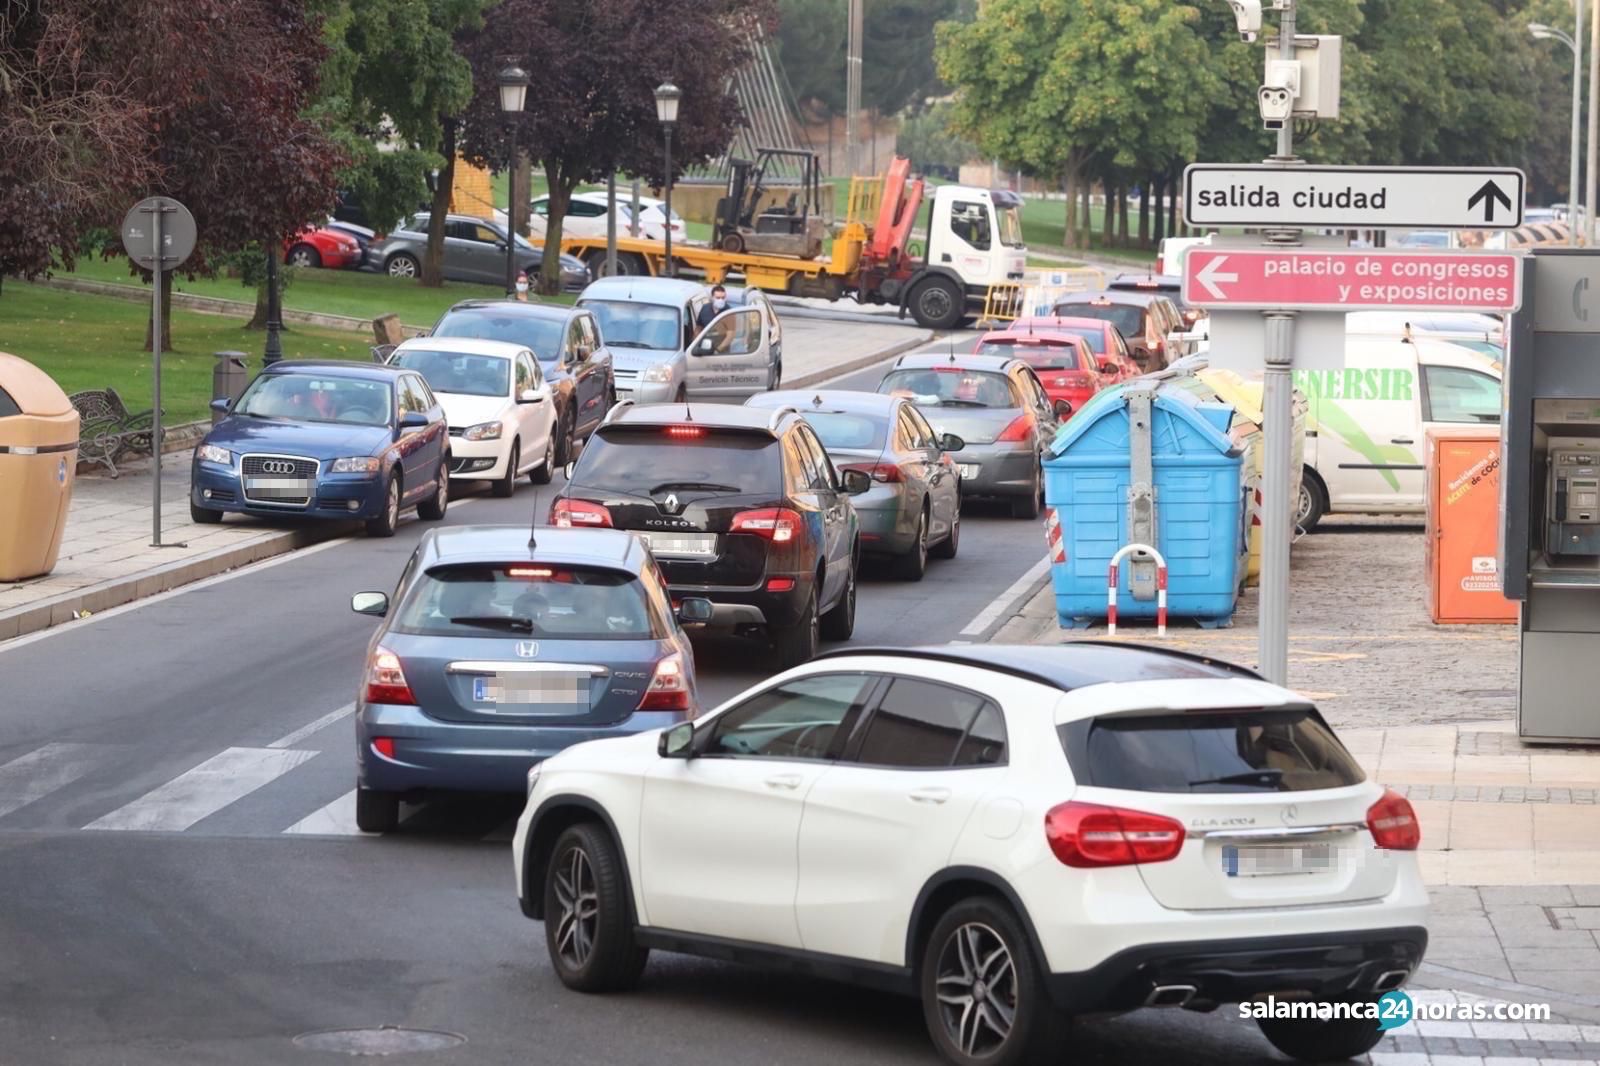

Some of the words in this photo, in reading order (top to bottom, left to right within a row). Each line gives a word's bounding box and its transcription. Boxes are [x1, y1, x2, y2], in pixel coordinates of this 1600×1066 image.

[1198, 185, 1280, 207] salida
[1293, 186, 1386, 209] ciudad
[1264, 257, 1346, 277] palacio
[1355, 258, 1383, 276] de
[1391, 262, 1509, 279] congresos
[1339, 284, 1351, 301] y
[1359, 282, 1508, 301] exposiciones
[699, 375, 729, 384] Servicio
[1471, 476, 1482, 485] de
[646, 519, 696, 527] KOLEOS
